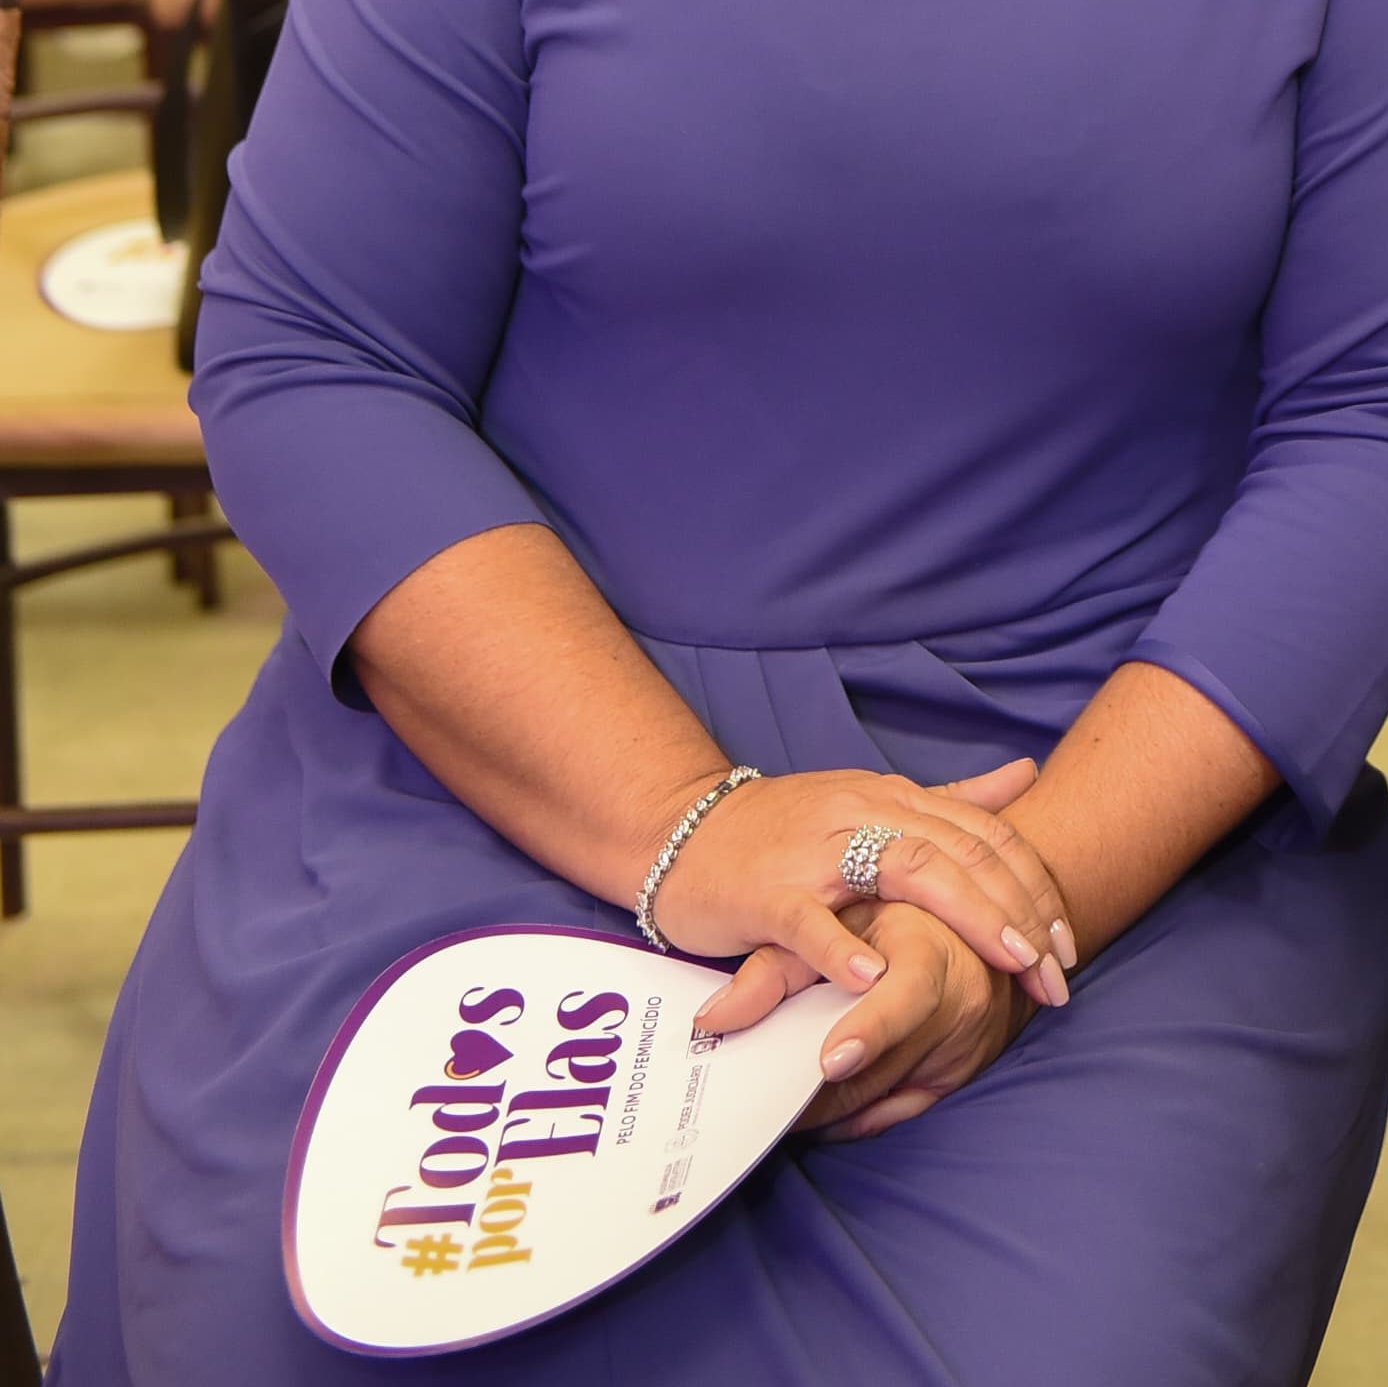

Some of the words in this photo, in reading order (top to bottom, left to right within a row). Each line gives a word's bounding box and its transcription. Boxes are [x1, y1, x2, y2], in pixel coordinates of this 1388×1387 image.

[634, 996, 662, 1069] FEMINICÍDIO
[494, 990, 630, 1167] Elas
[624, 1092, 641, 1113] FIM
[629, 1072, 647, 1091] DO
[616, 1115, 637, 1145] PELO
[467, 1167, 533, 1272] por
